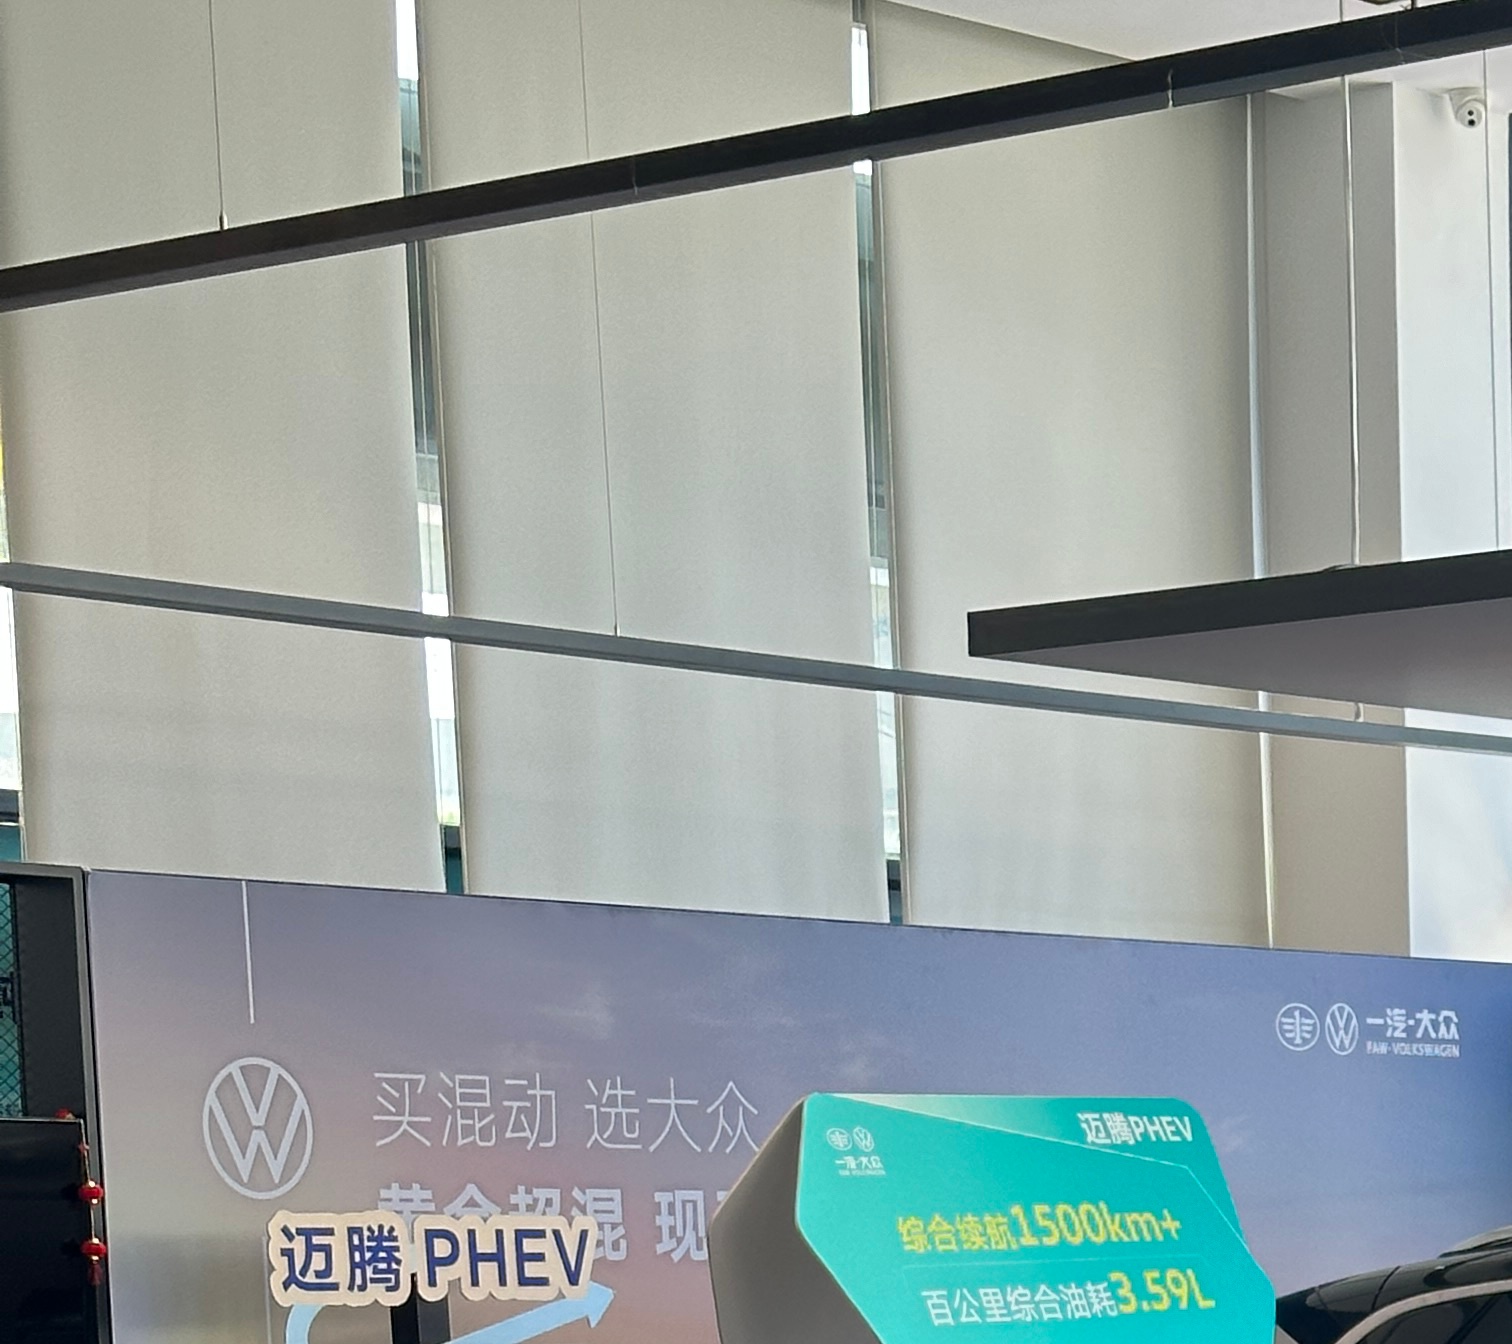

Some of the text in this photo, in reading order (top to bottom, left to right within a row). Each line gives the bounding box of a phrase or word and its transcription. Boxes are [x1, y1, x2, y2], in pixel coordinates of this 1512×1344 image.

[373, 1072, 760, 1153] 买混动 选大众
[1077, 1111, 1193, 1146] 迈腾PHEV
[654, 1189, 730, 1264] 现
[897, 1201, 1182, 1253] 综合续航1500km+
[280, 1224, 589, 1293] 迈腾 PHEV
[921, 1268, 1216, 1326] 百公里综合油耗3.59L
